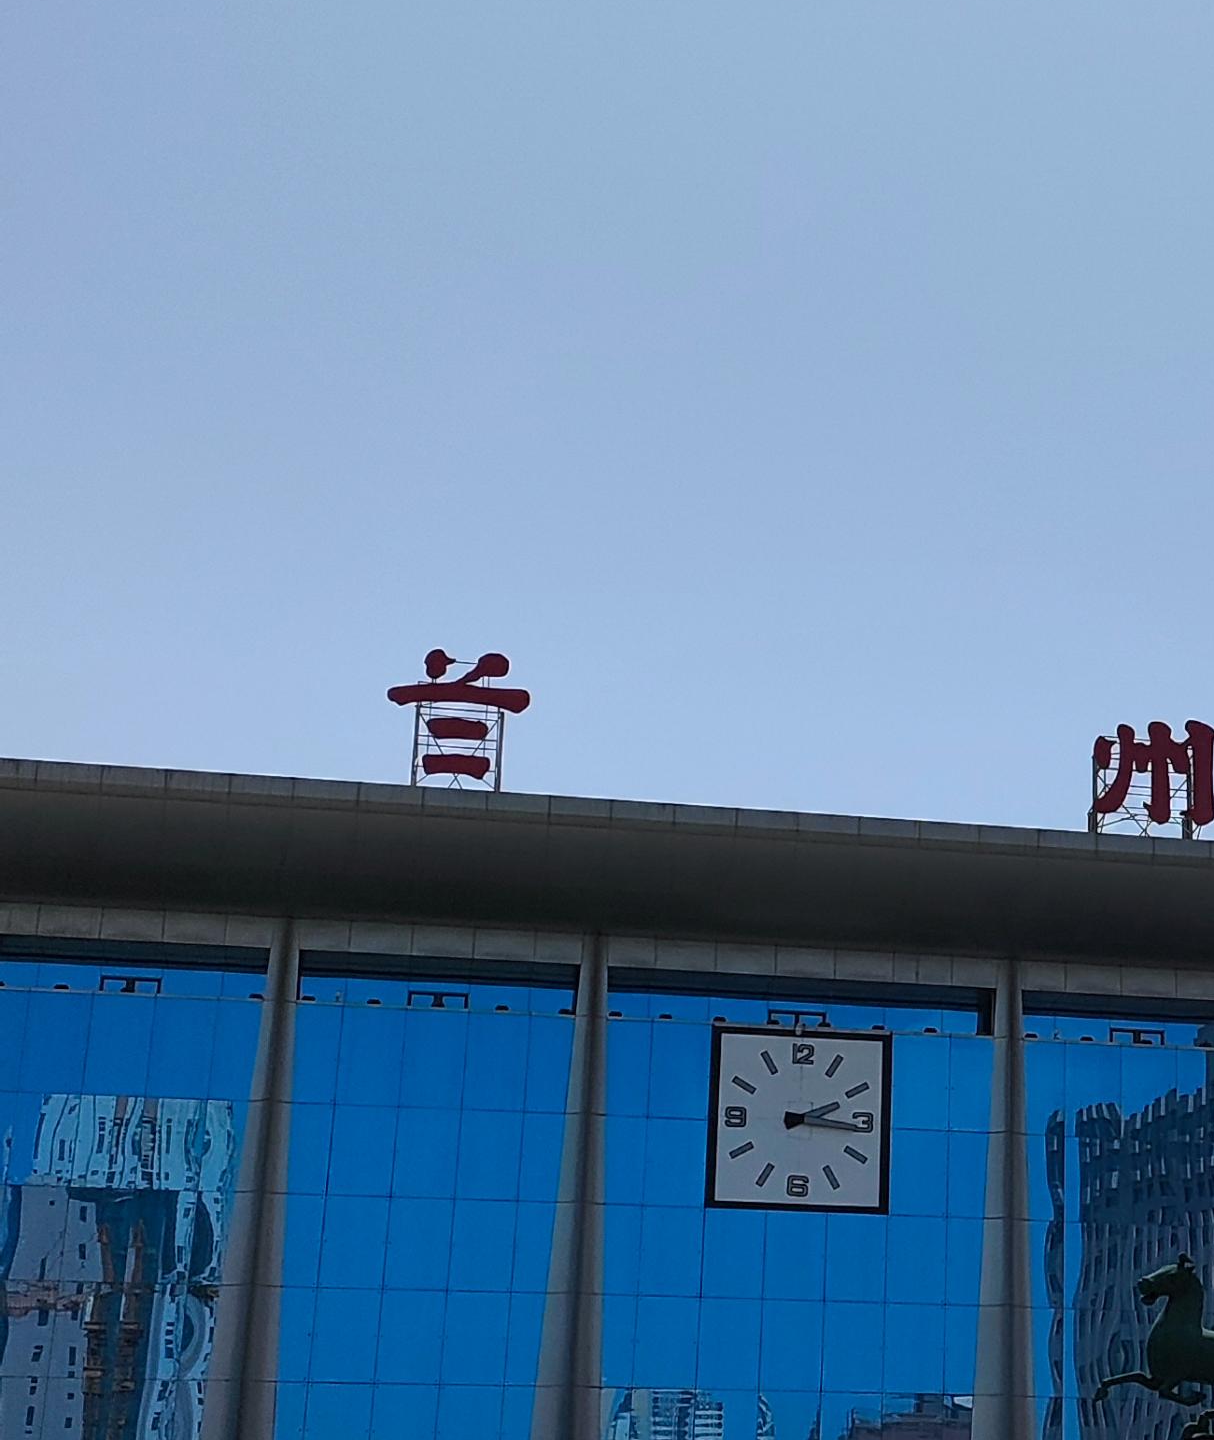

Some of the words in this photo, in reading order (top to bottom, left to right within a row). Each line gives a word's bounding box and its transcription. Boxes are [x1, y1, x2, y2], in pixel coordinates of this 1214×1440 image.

[387, 648, 530, 779] 兰
[792, 1043, 815, 1065] 12
[725, 1106, 747, 1128] 9
[852, 1112, 874, 1133] 3
[786, 1174, 809, 1197] 6
